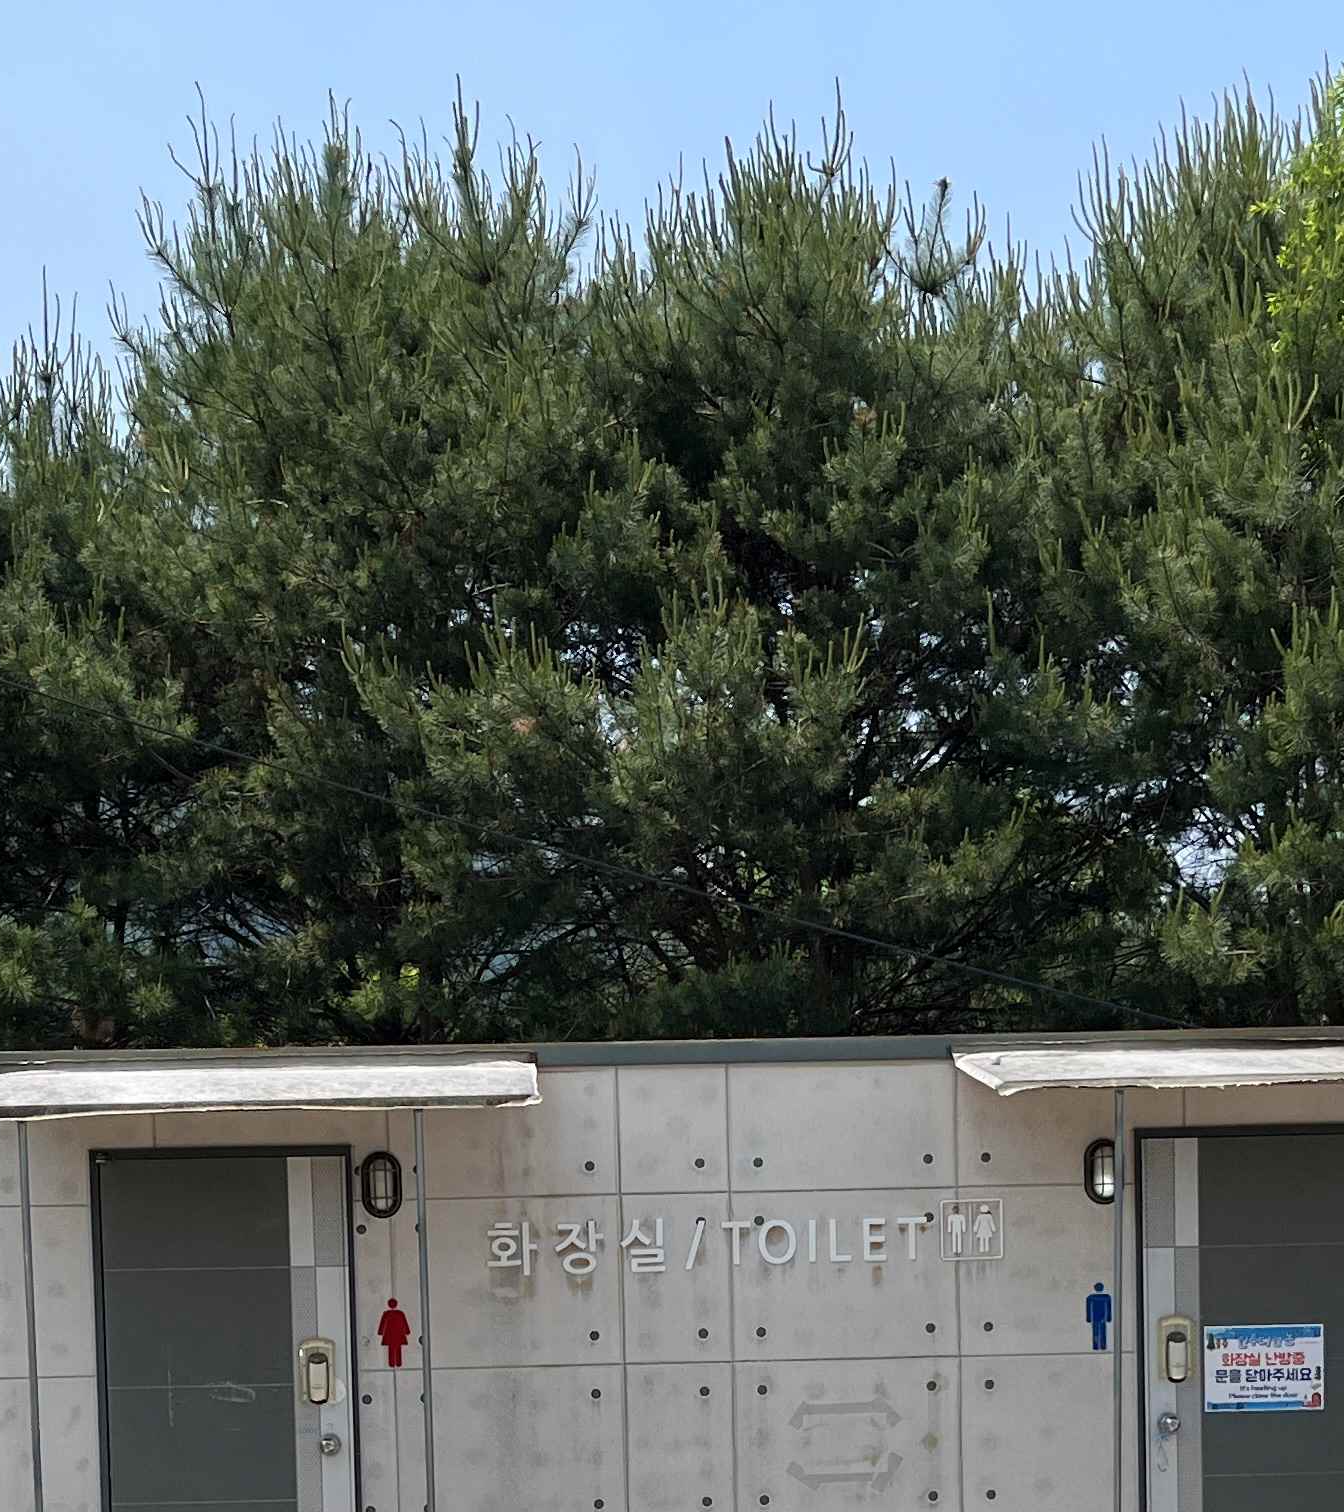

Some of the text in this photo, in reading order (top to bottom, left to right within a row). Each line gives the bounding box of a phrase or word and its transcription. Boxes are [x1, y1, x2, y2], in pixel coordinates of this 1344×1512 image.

[1222, 1352, 1261, 1366] 화장실
[1215, 1367, 1312, 1383] 문을 닫아주세요
